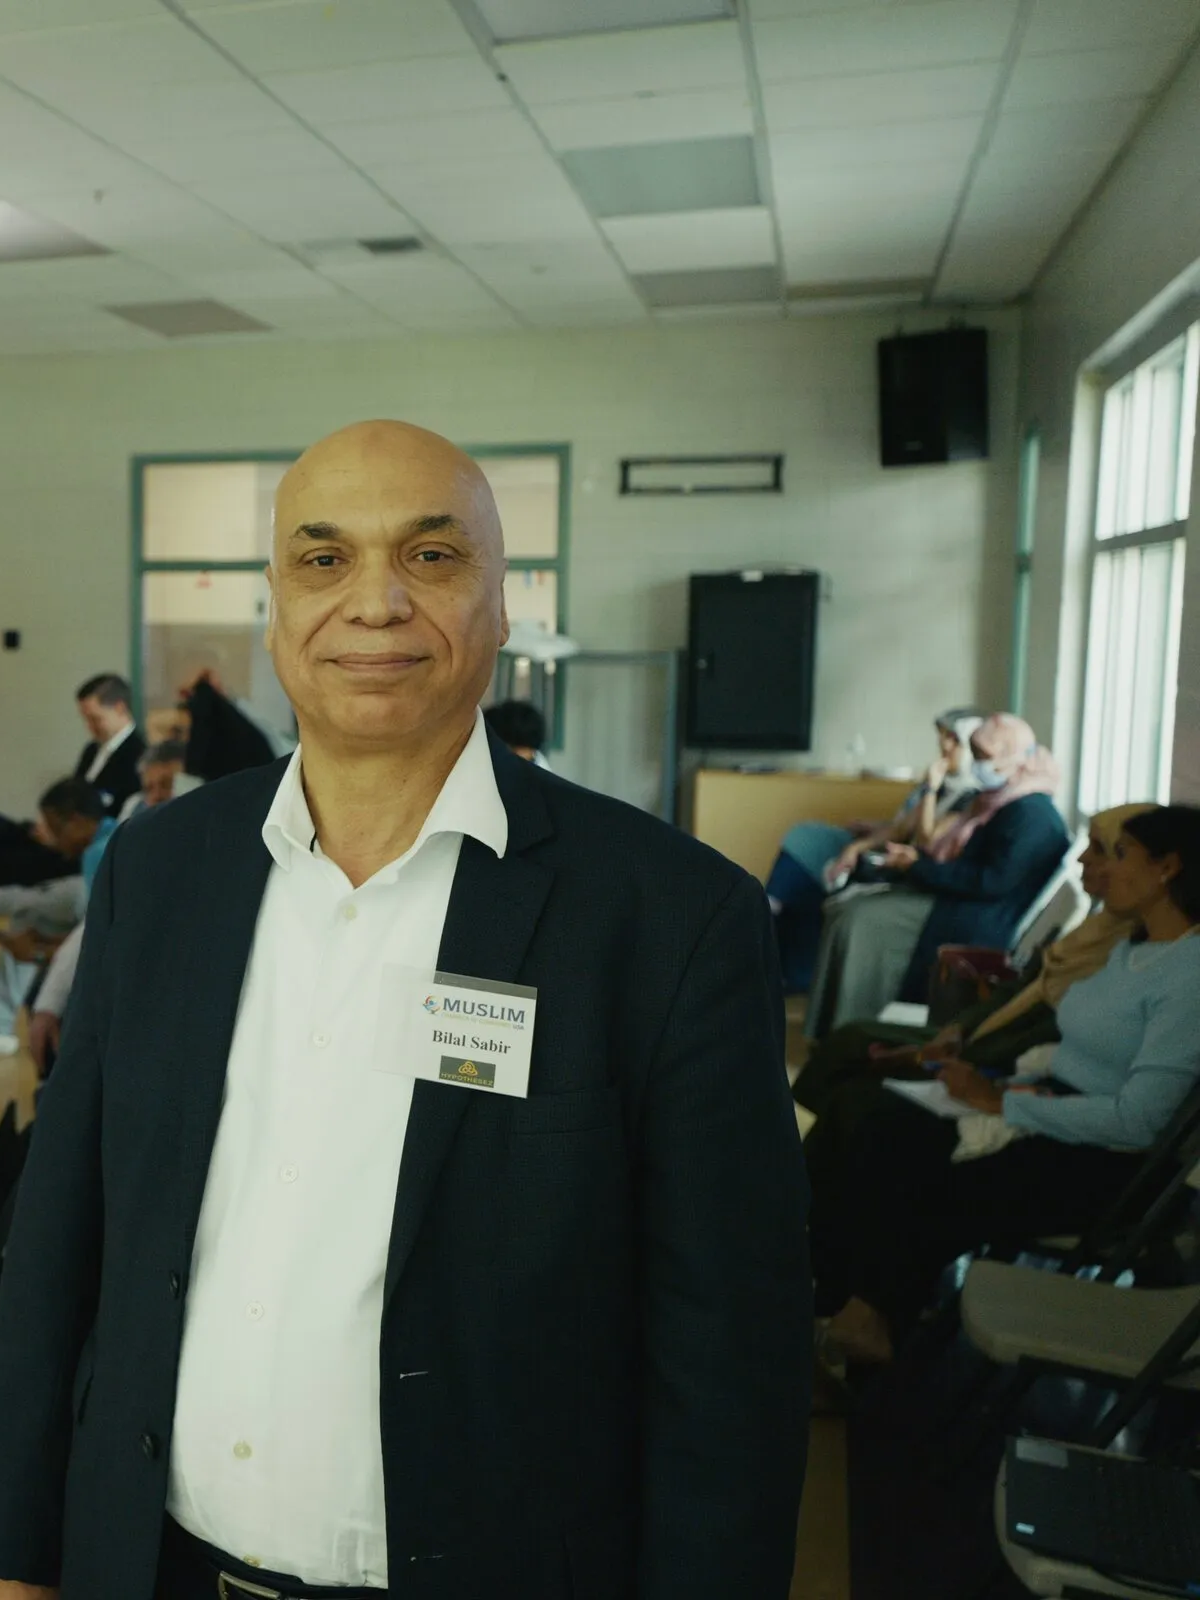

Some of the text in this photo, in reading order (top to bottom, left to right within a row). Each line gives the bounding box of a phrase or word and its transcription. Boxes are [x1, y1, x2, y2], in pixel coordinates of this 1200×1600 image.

[443, 998, 525, 1023] MUSLIM
[432, 1030, 511, 1054] Bilal Sabir
